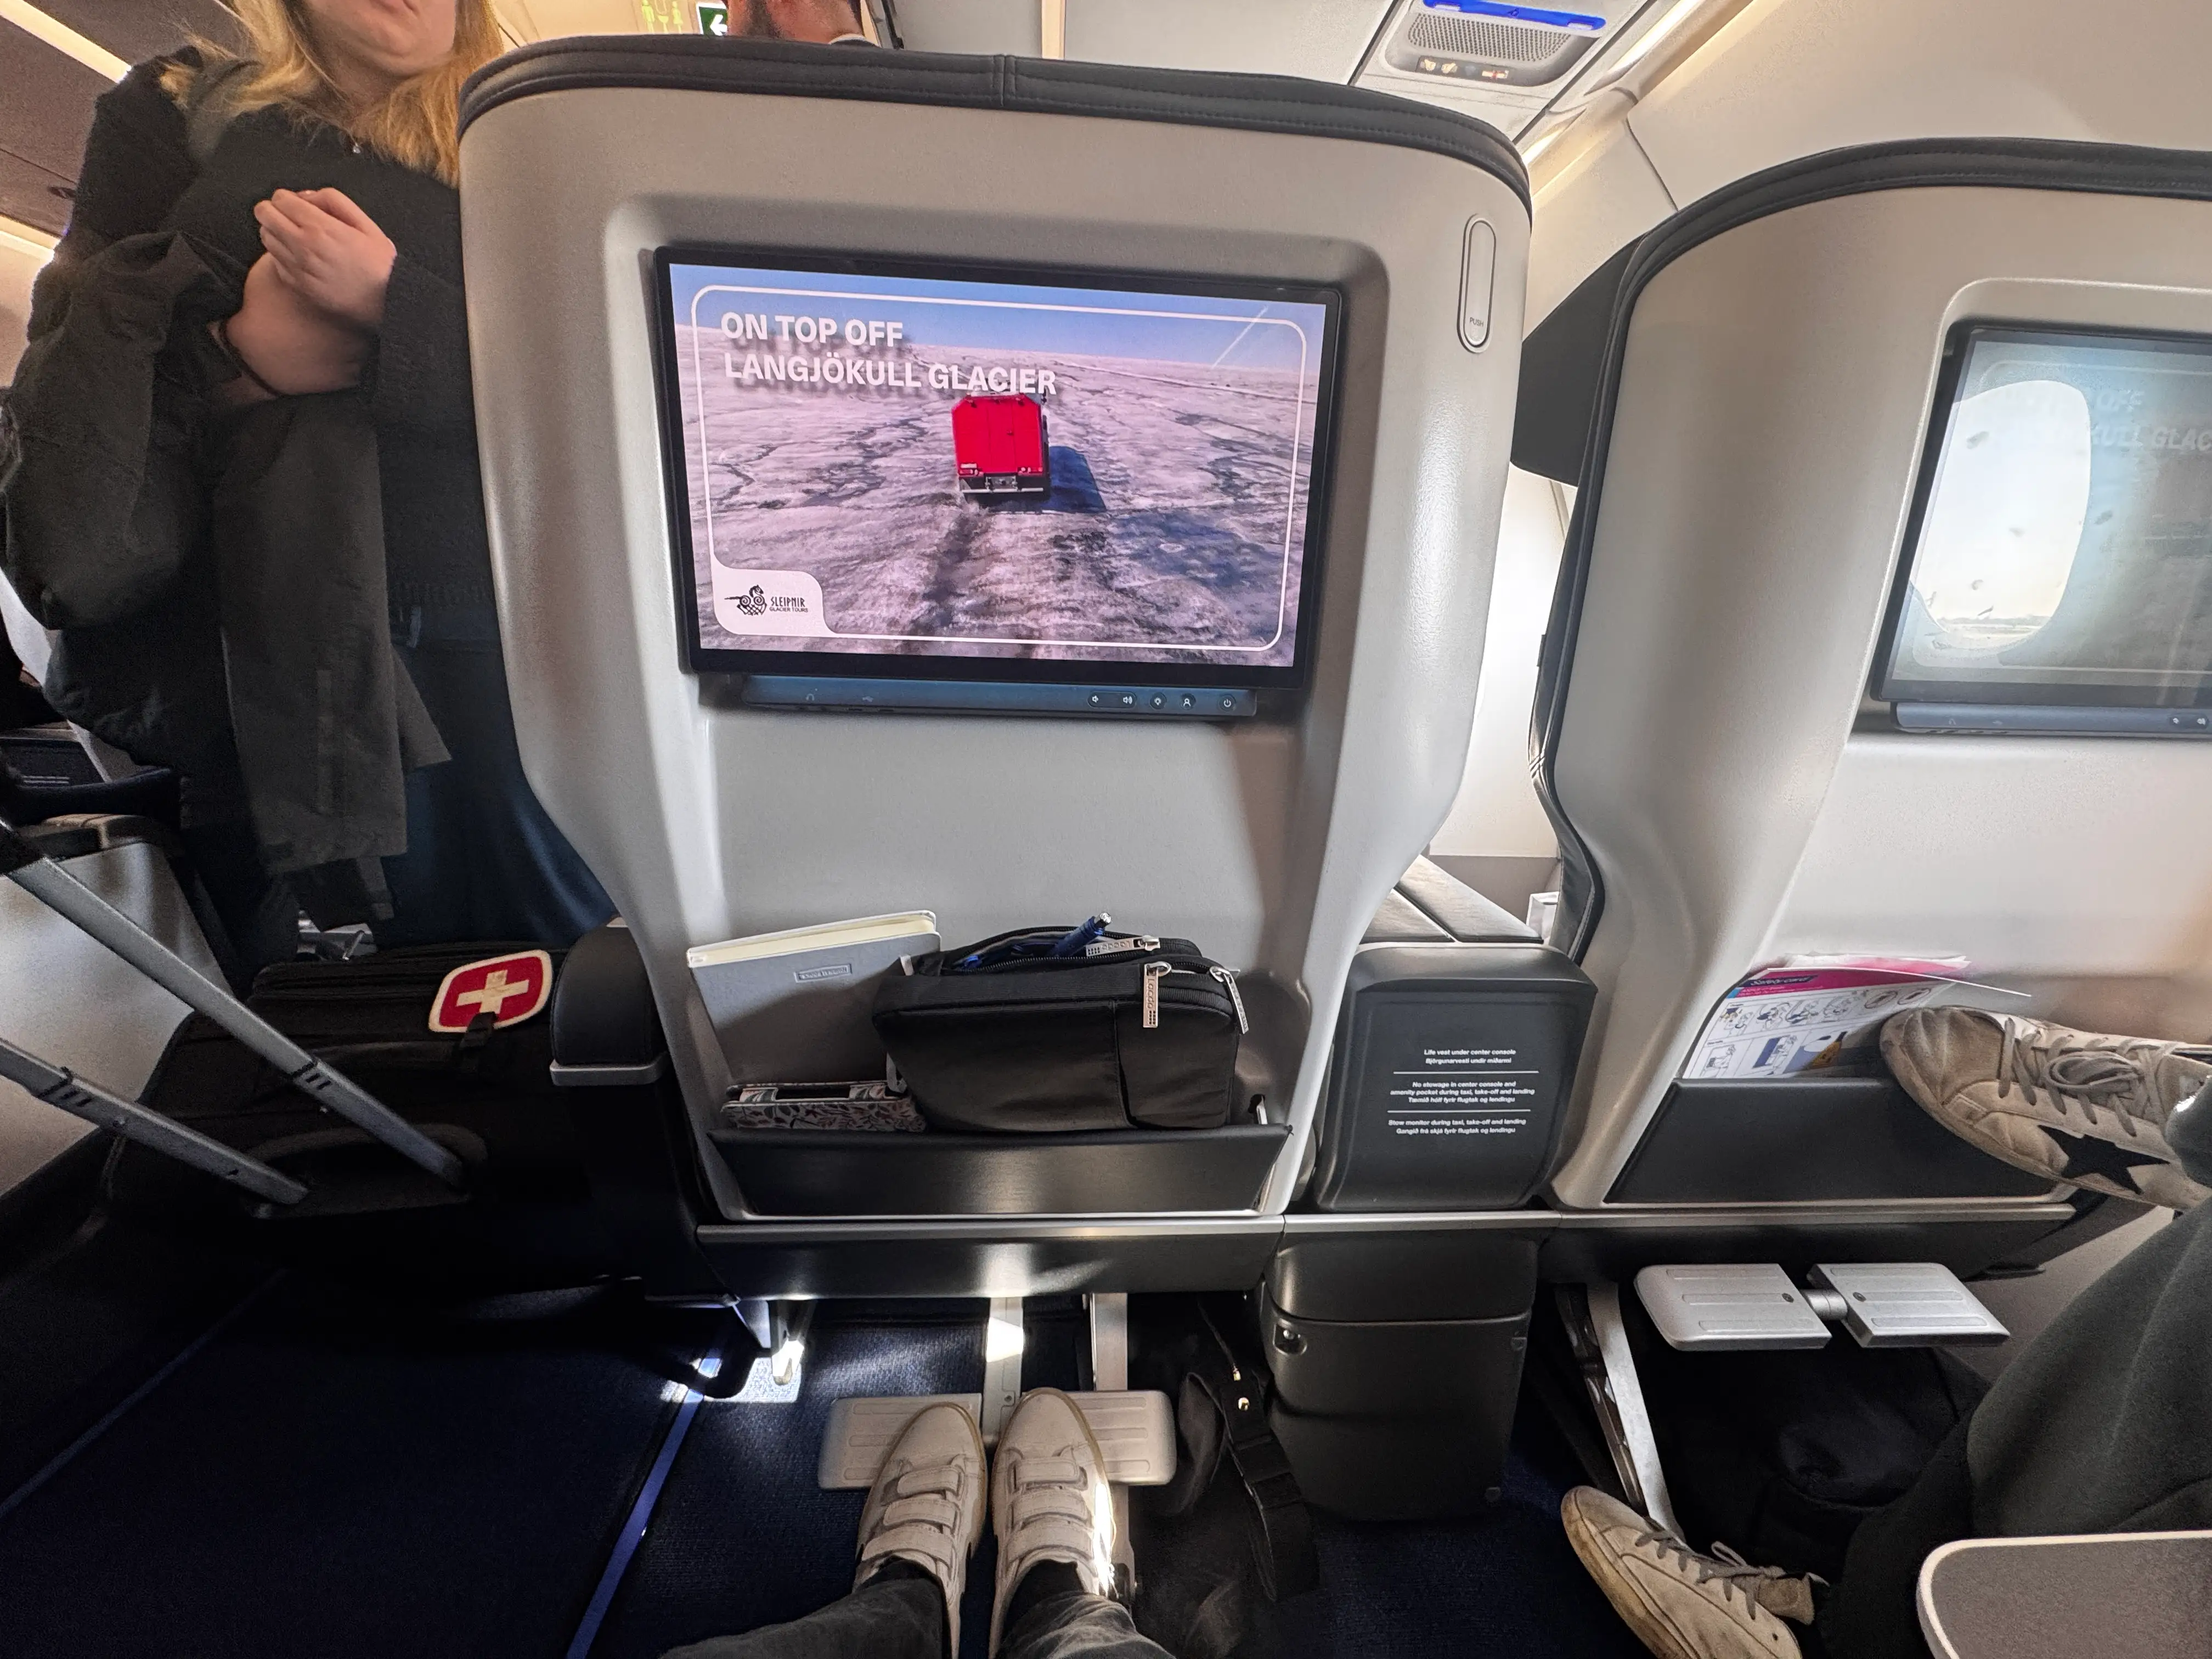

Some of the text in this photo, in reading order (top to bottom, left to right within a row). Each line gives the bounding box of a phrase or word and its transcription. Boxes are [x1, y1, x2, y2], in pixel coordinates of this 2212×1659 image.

[721, 313, 903, 347] ON TOP OFF
[1469, 317, 1484, 327] PUSH
[724, 352, 1057, 395] LANGJÖKULL GLACIER
[770, 596, 806, 607] SLEIPNIR
